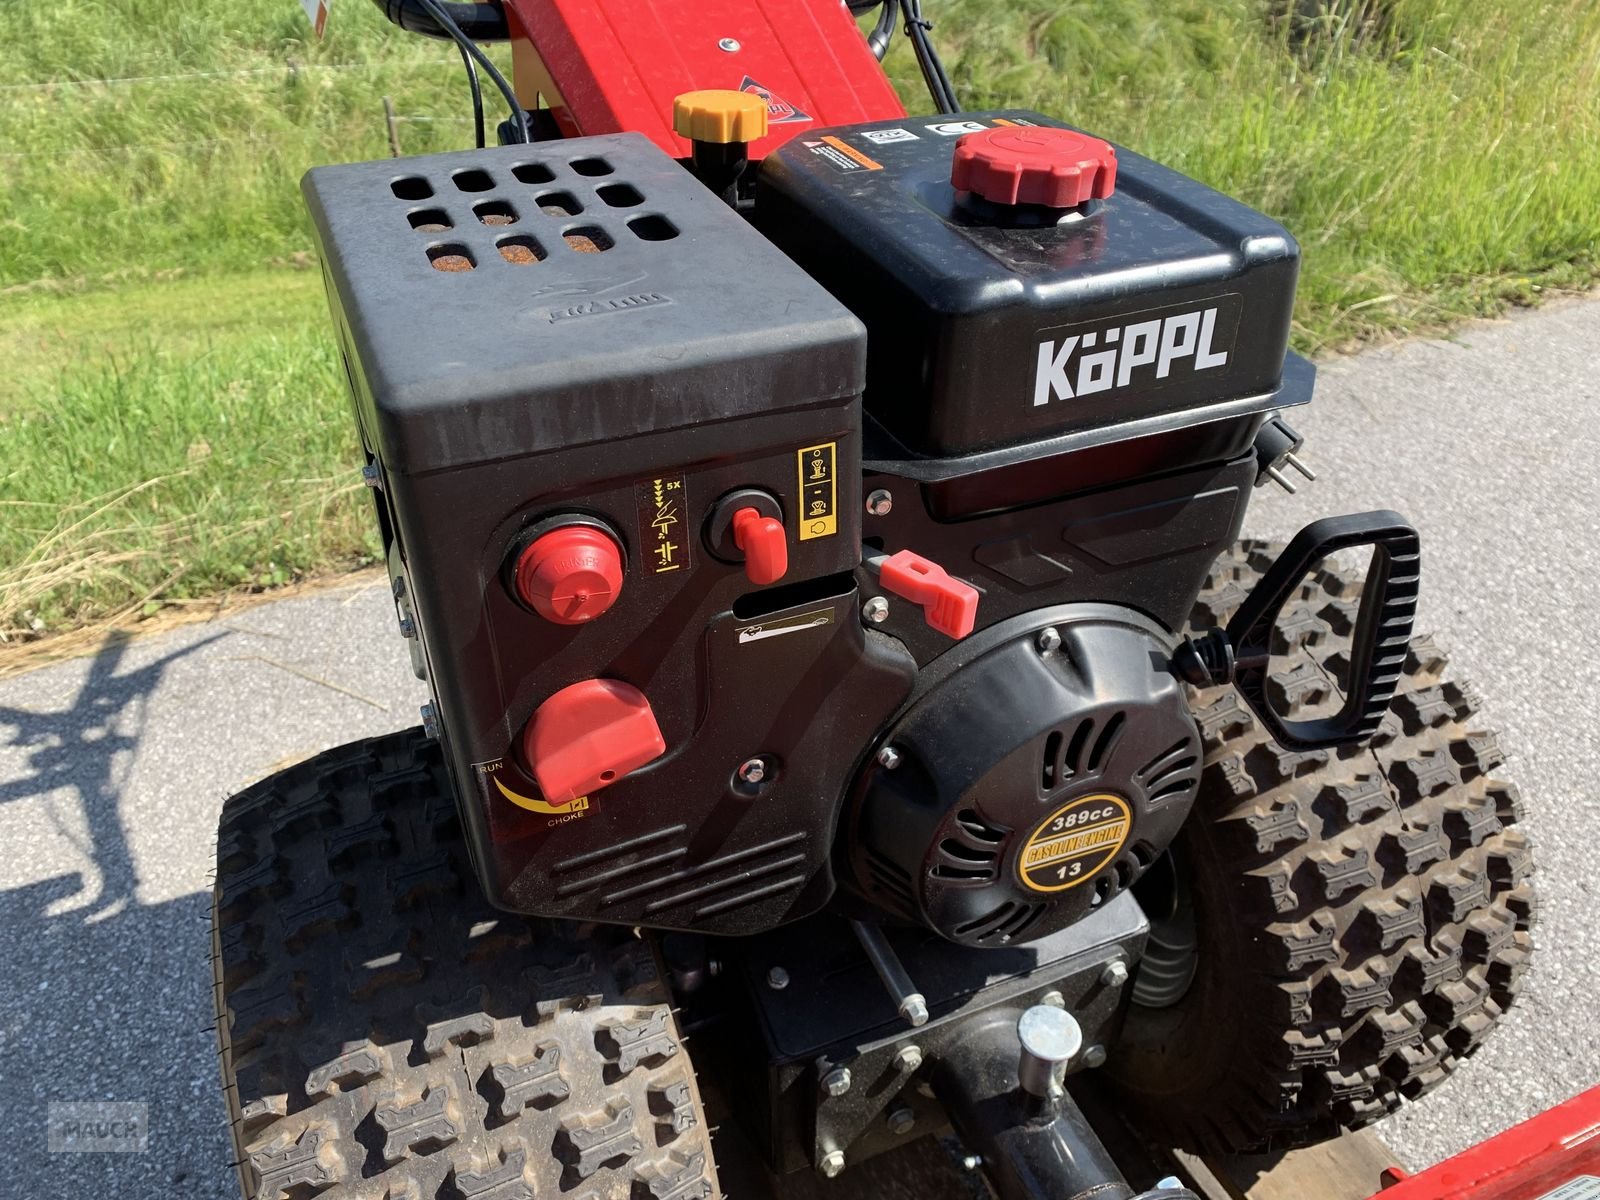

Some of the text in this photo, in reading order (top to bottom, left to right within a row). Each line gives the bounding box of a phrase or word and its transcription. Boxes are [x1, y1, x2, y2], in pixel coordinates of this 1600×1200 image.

[480, 762, 503, 774] RUN
[547, 811, 584, 827] CHOKE
[1052, 807, 1114, 831] 389cc
[1027, 824, 1124, 863] GASOLINE ENGINE
[1057, 862, 1082, 880] 13
